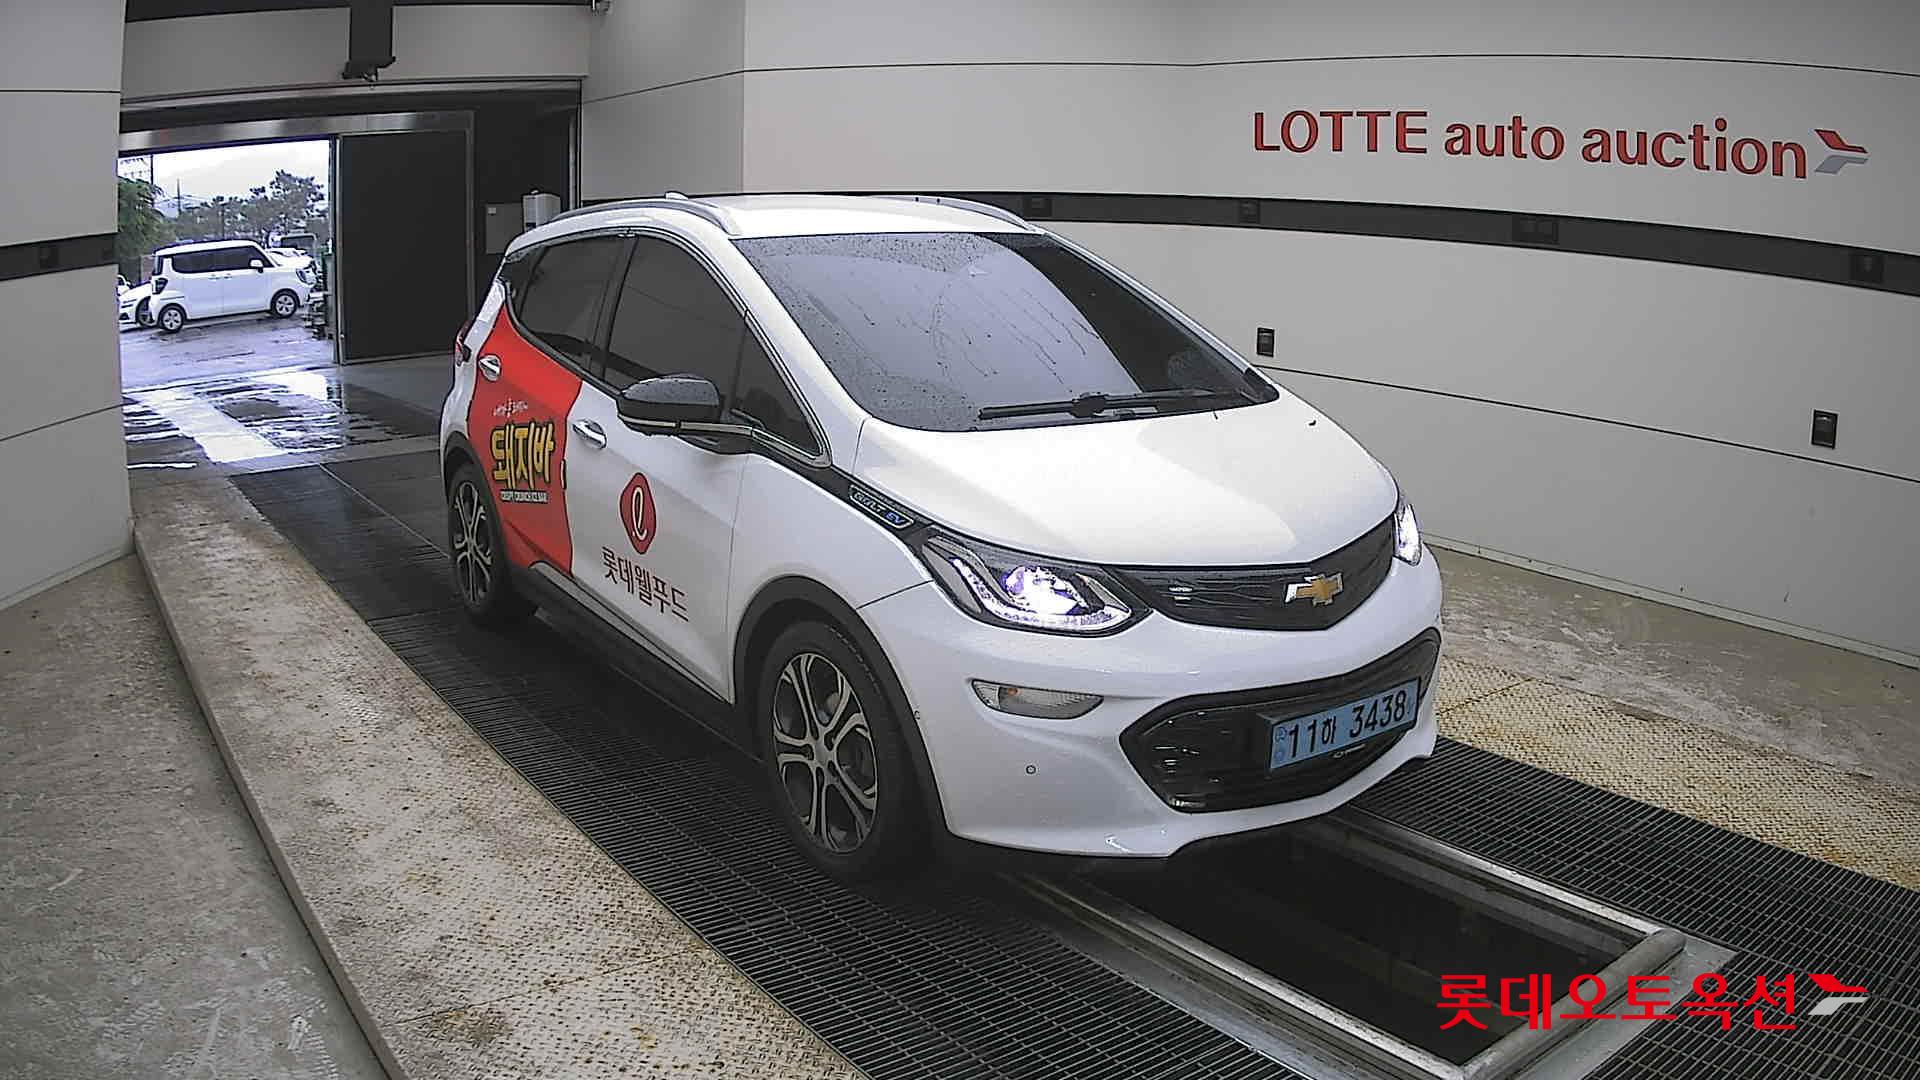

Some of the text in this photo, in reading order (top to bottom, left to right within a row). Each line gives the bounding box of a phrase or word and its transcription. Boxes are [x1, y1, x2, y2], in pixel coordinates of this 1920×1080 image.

[1253, 109, 1808, 180] LOTTE auto auction
[490, 421, 556, 489] 돼지바
[602, 546, 689, 622] 롯데웰푸드
[1288, 715, 1337, 758] 11하
[1349, 690, 1408, 738] 3438
